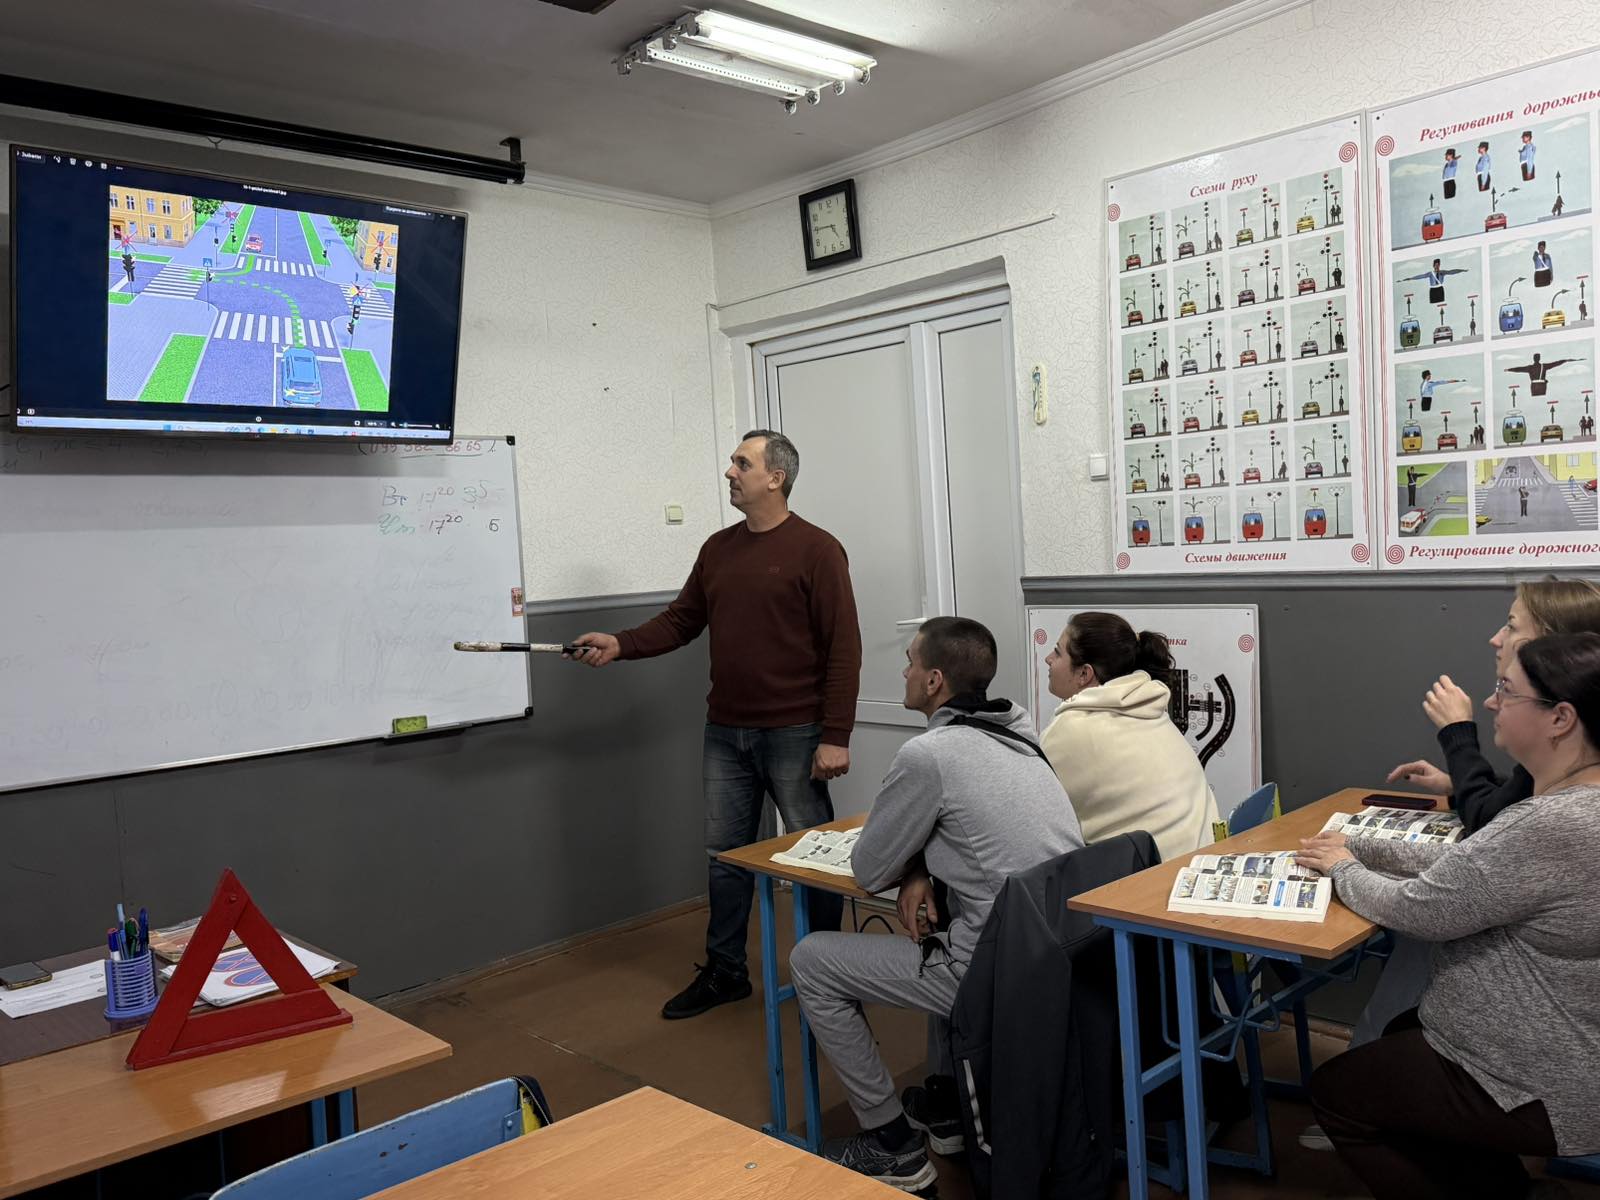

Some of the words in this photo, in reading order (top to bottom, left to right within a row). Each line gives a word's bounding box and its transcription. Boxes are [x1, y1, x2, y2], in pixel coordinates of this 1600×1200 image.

[1420, 110, 1514, 141] Регулювання
[1190, 182, 1226, 198] Схеми
[1232, 173, 1258, 191] руху
[1185, 552, 1223, 563] Схемы
[1225, 551, 1287, 562] движения
[1410, 544, 1515, 560] Регулирование
[1519, 542, 1600, 558] дорожног
